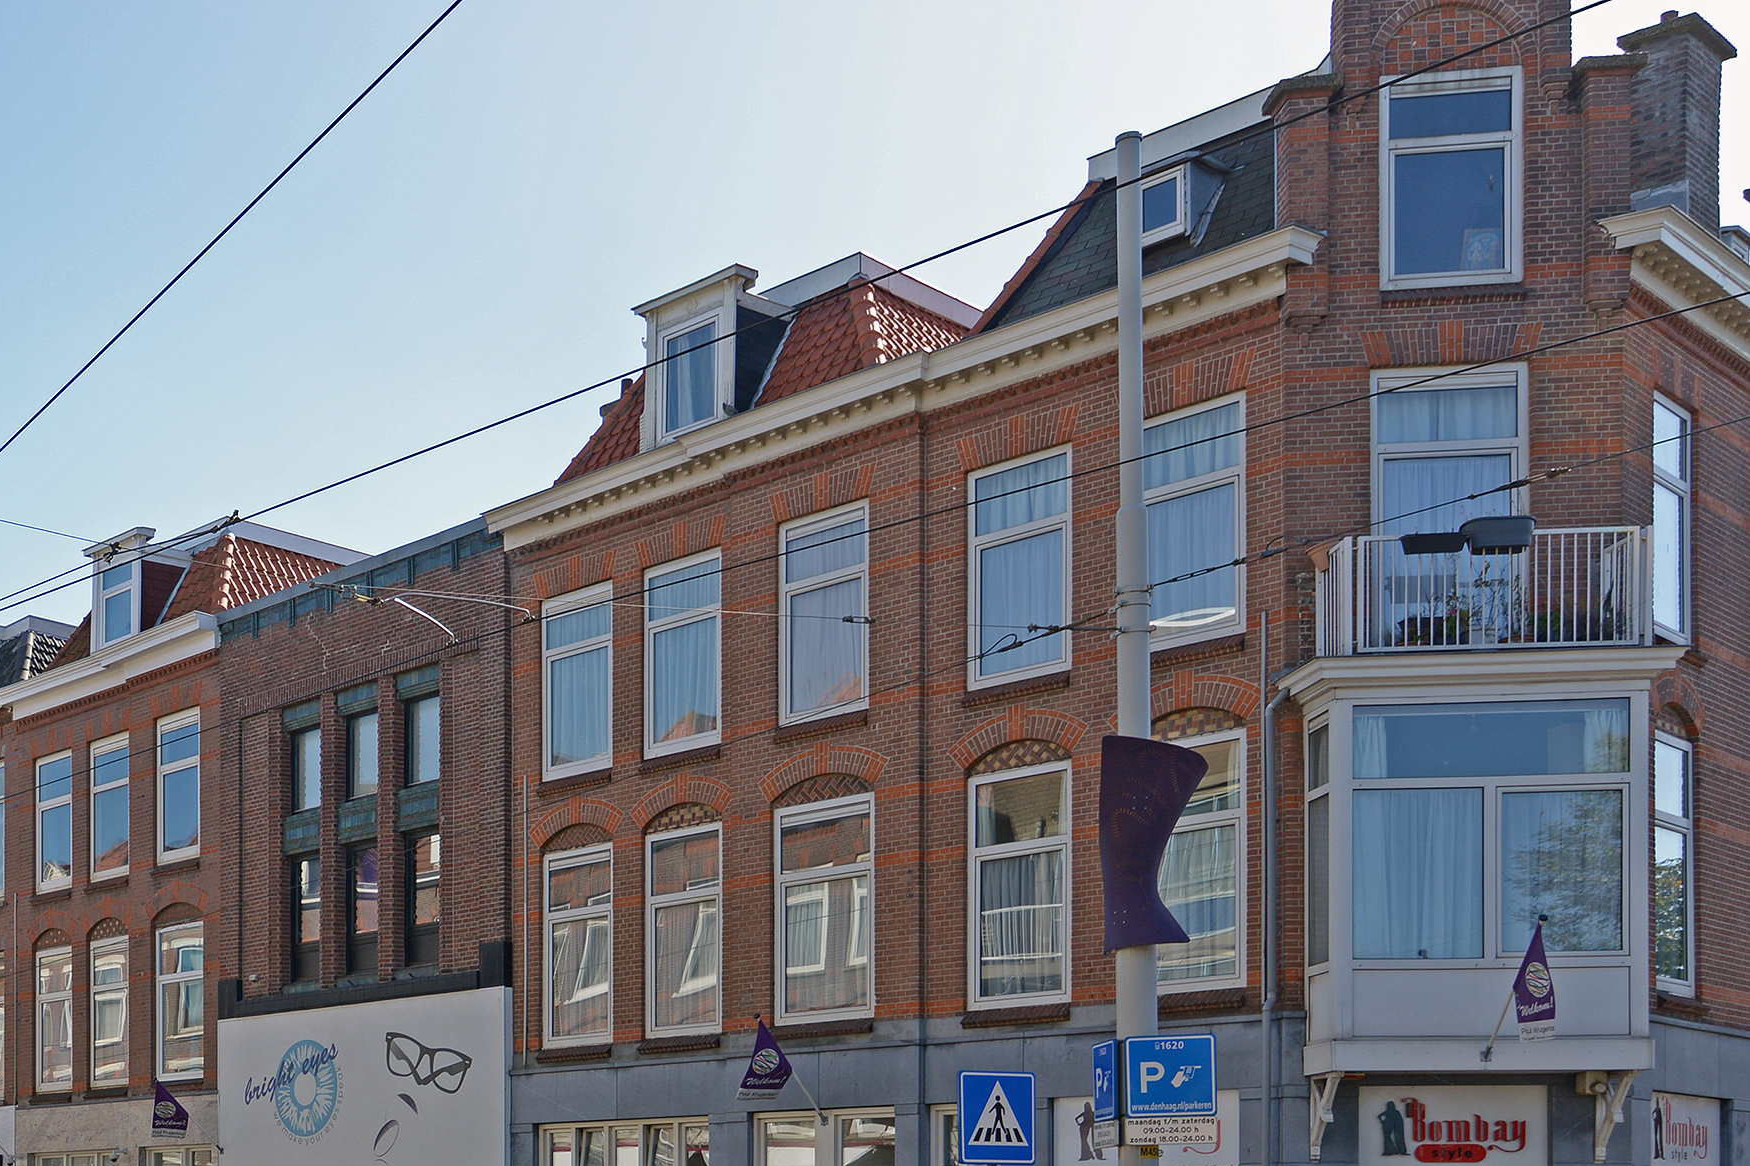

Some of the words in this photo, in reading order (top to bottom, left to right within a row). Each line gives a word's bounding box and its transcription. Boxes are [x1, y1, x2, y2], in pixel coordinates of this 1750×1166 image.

[1160, 1041, 1185, 1050] 1620
[244, 1060, 295, 1106] bright
[301, 1043, 339, 1076] eyes
[1140, 1061, 1165, 1094] P
[1096, 1067, 1103, 1099] P
[281, 1126, 303, 1145] make
[304, 1132, 324, 1147] your
[324, 1108, 340, 1134] eyes
[336, 1065, 345, 1105] speak
[1131, 1100, 1212, 1112] www.denhaag.nl/parkeren
[1127, 1118, 1161, 1127] maandag
[1181, 1117, 1215, 1126] zaterdag
[1401, 1097, 1526, 1153] Bombay
[1662, 1096, 1708, 1160] Bombay
[1142, 1127, 1192, 1135] 09.00-24.00
[1129, 1136, 1157, 1144] zondag
[1158, 1135, 1206, 1143] 18.00-24.00
[1432, 1147, 1473, 1160] style
[1671, 1148, 1688, 1163] style
